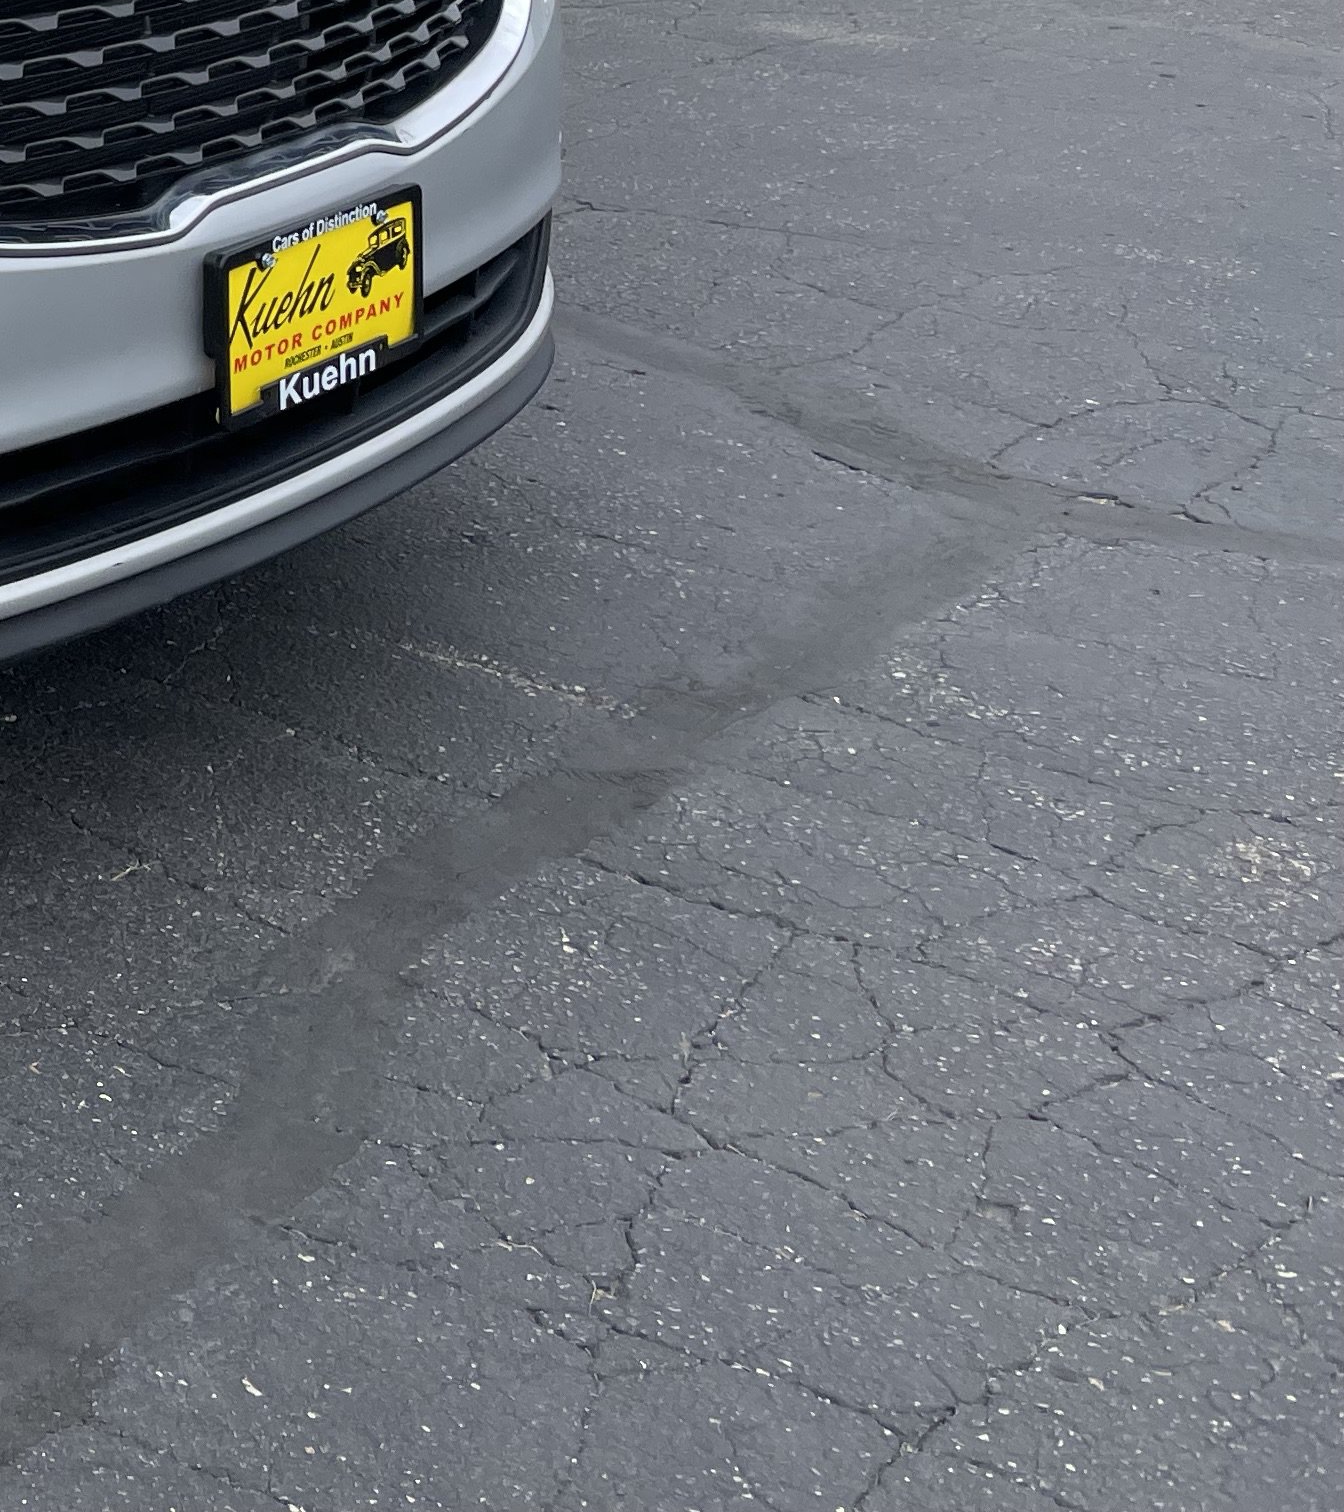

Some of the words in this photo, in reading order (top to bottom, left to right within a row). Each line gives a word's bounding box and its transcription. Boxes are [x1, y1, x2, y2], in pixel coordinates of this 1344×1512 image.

[271, 232, 300, 253] Cars
[301, 225, 316, 241] of
[316, 202, 378, 236] Distinction
[229, 243, 336, 351] Kuehn
[233, 332, 303, 375] MOTOR
[311, 292, 405, 341] COMPANY
[278, 347, 377, 410] Kuehn
